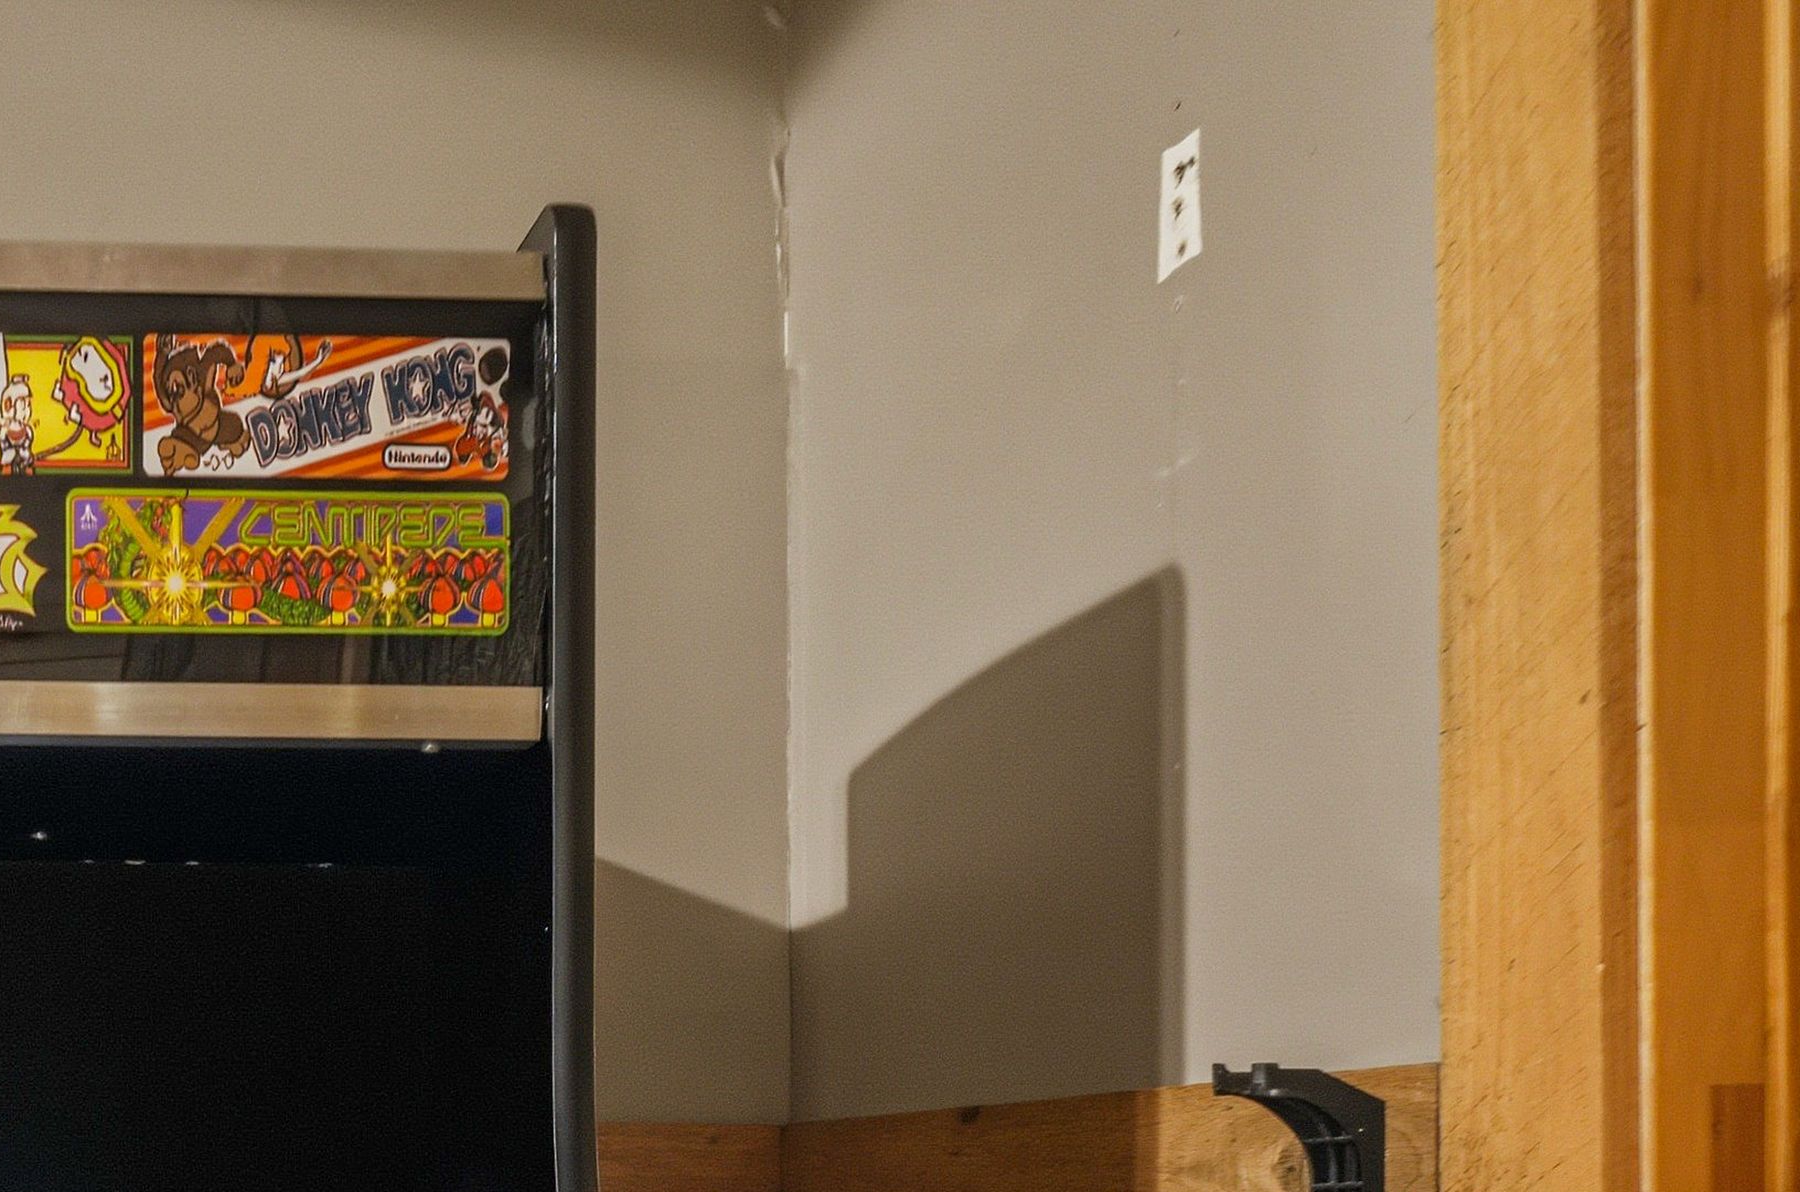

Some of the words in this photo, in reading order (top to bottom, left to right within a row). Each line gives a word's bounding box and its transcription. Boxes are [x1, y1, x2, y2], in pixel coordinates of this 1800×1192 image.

[246, 372, 374, 468] DONKEY
[381, 342, 477, 425] KONG
[387, 448, 448, 465] Nintendo
[239, 504, 490, 548] CENTIPEDE
